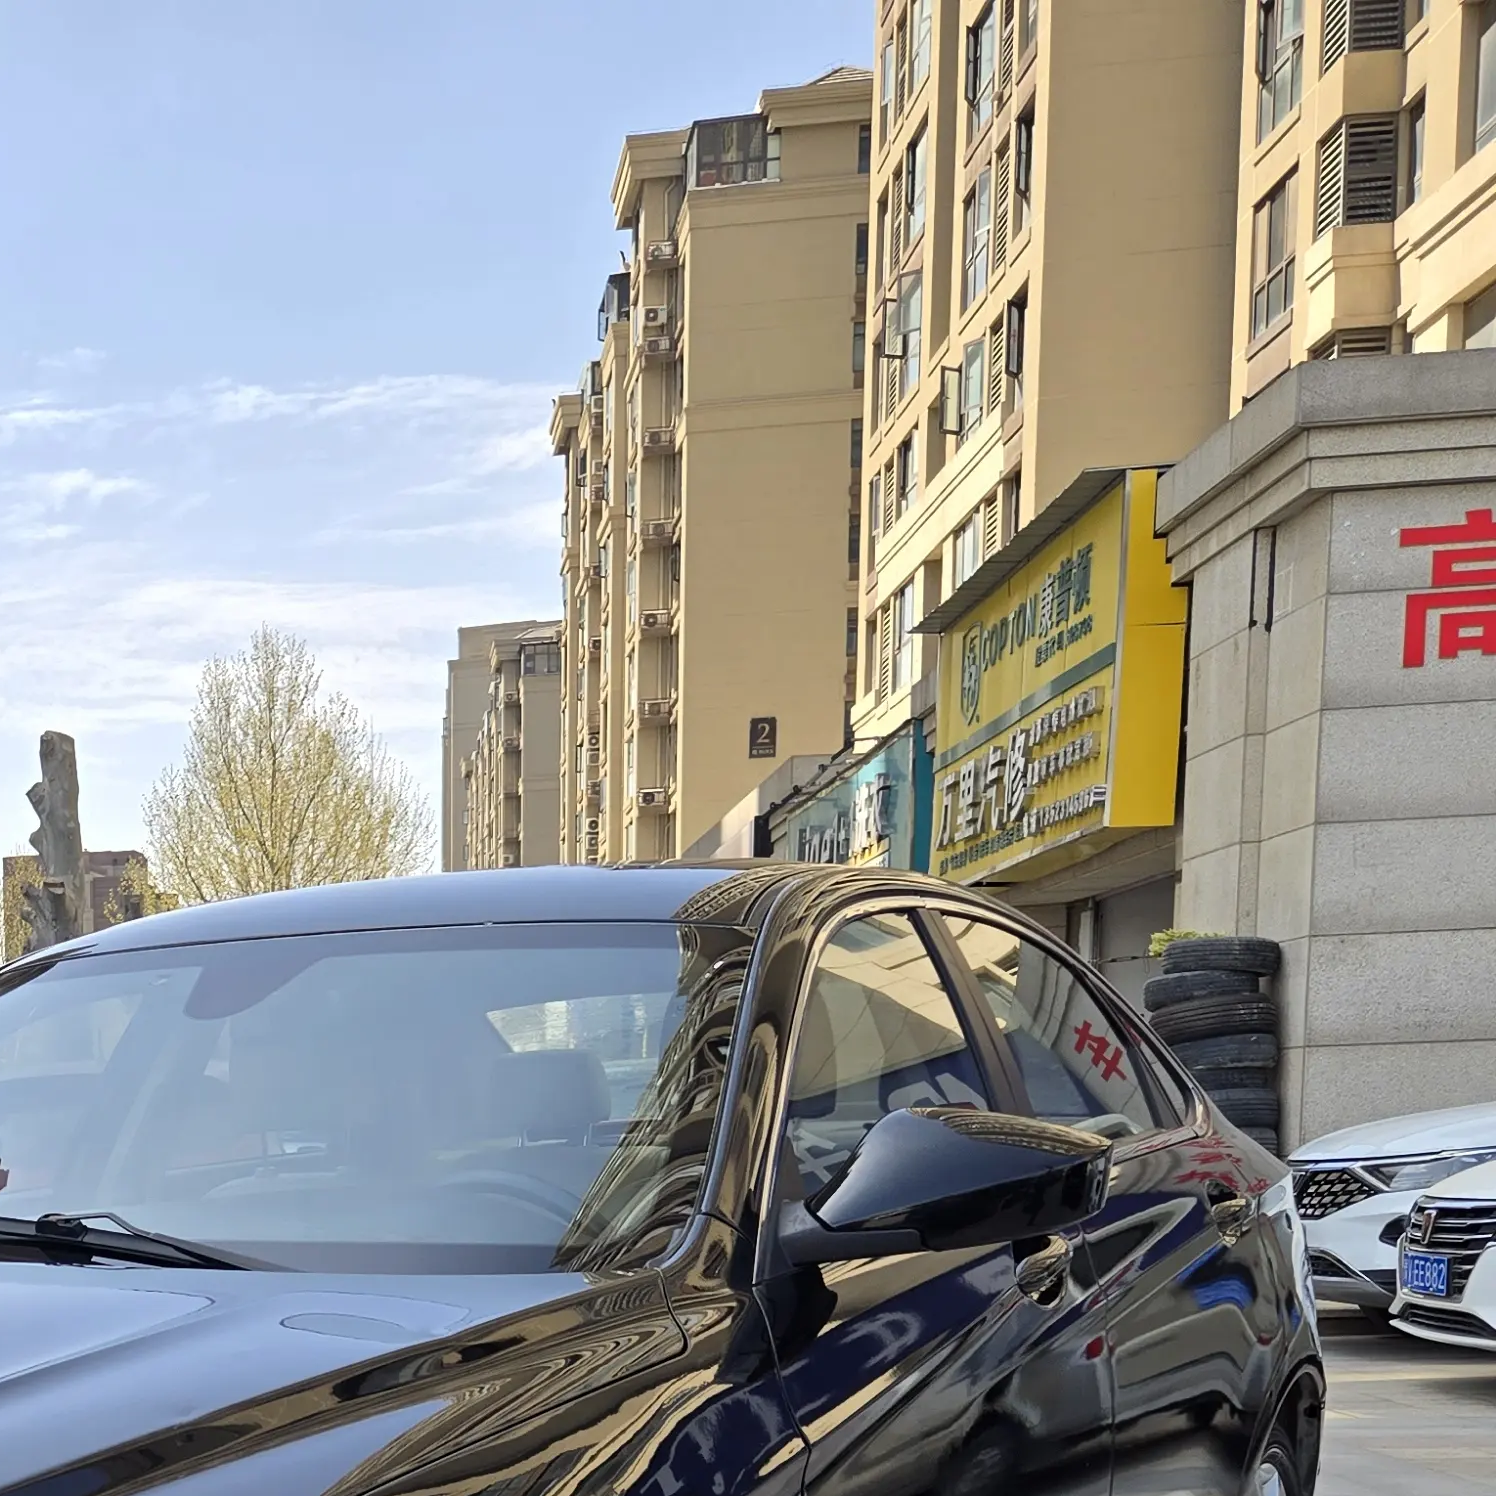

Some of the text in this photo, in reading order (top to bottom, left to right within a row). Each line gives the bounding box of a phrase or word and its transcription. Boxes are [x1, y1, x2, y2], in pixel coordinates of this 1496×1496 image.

[982, 541, 1094, 673] COPTON 康普顿
[1399, 508, 1496, 668] 高
[756, 723, 770, 743] 2
[936, 727, 1029, 852] 万里汽修
